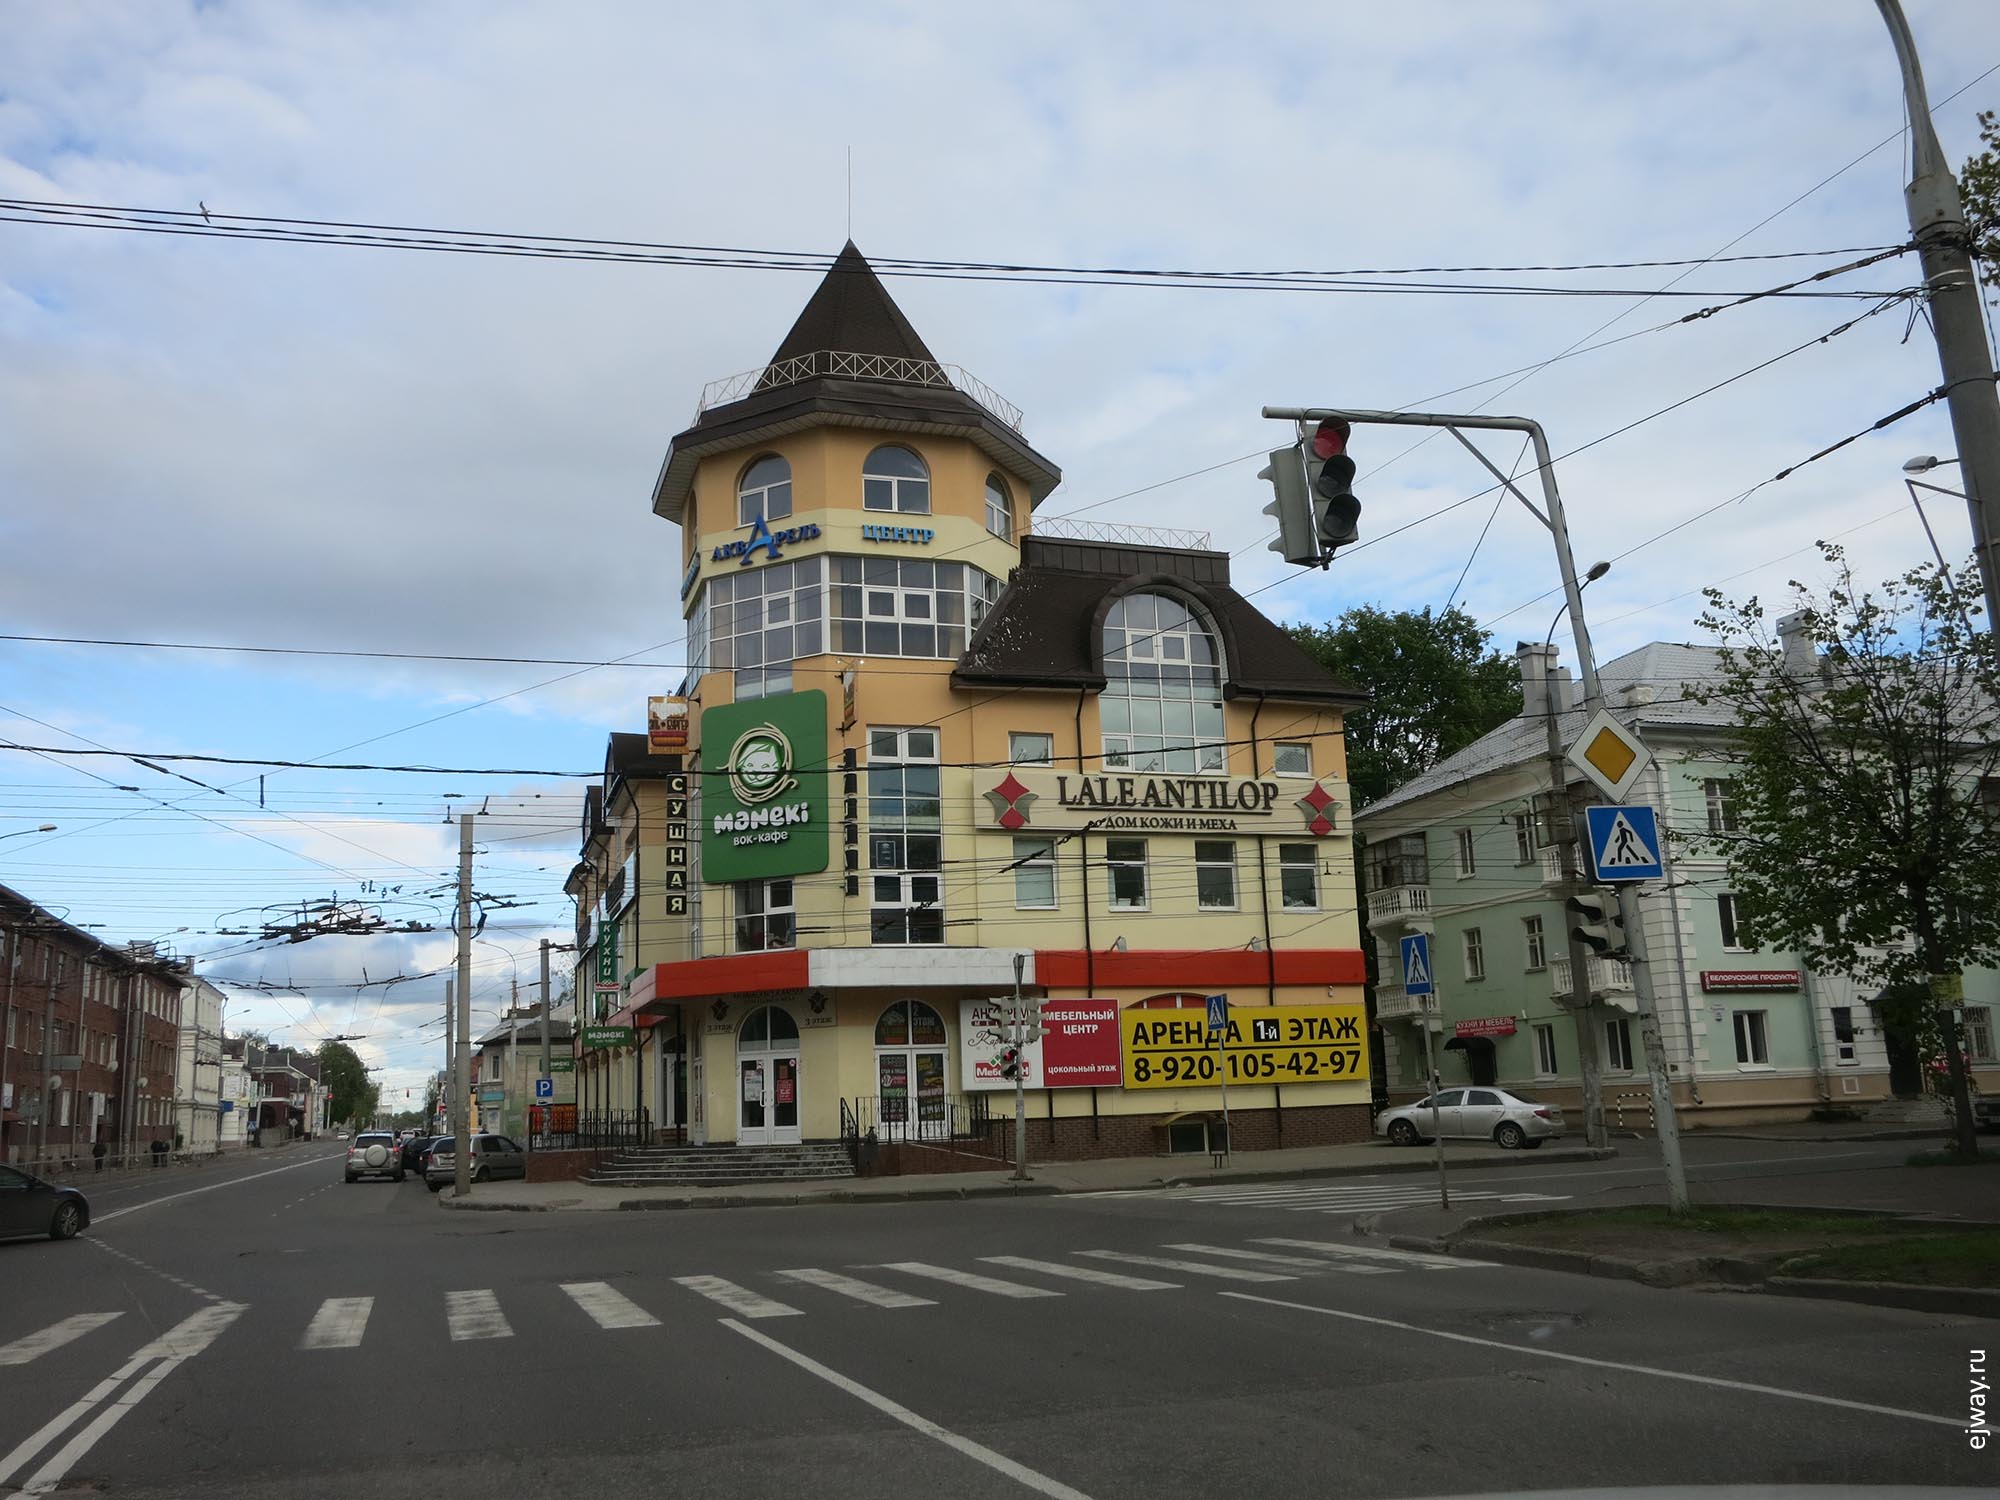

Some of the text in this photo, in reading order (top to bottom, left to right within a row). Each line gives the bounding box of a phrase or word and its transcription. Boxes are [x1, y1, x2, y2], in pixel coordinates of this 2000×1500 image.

[710, 512, 936, 566] АКВАРЕЛЬ ЦЕНТР
[1057, 775, 1279, 811] LALE ANTILOP
[1104, 816, 1238, 831] ДОМ КОЖИ И МЕХА
[733, 829, 789, 847] вок-кафе
[1046, 1008, 1115, 1022] МЕБЕЛЬНЫЙ
[1062, 1022, 1099, 1036] ЦЕНТР
[1132, 1019, 1243, 1050] АРЕНДА
[1288, 1016, 1361, 1041] ЭТАЖ
[1047, 1063, 1117, 1076] цокольный этаж
[1133, 1050, 1361, 1083] 8-920-105-42-97
